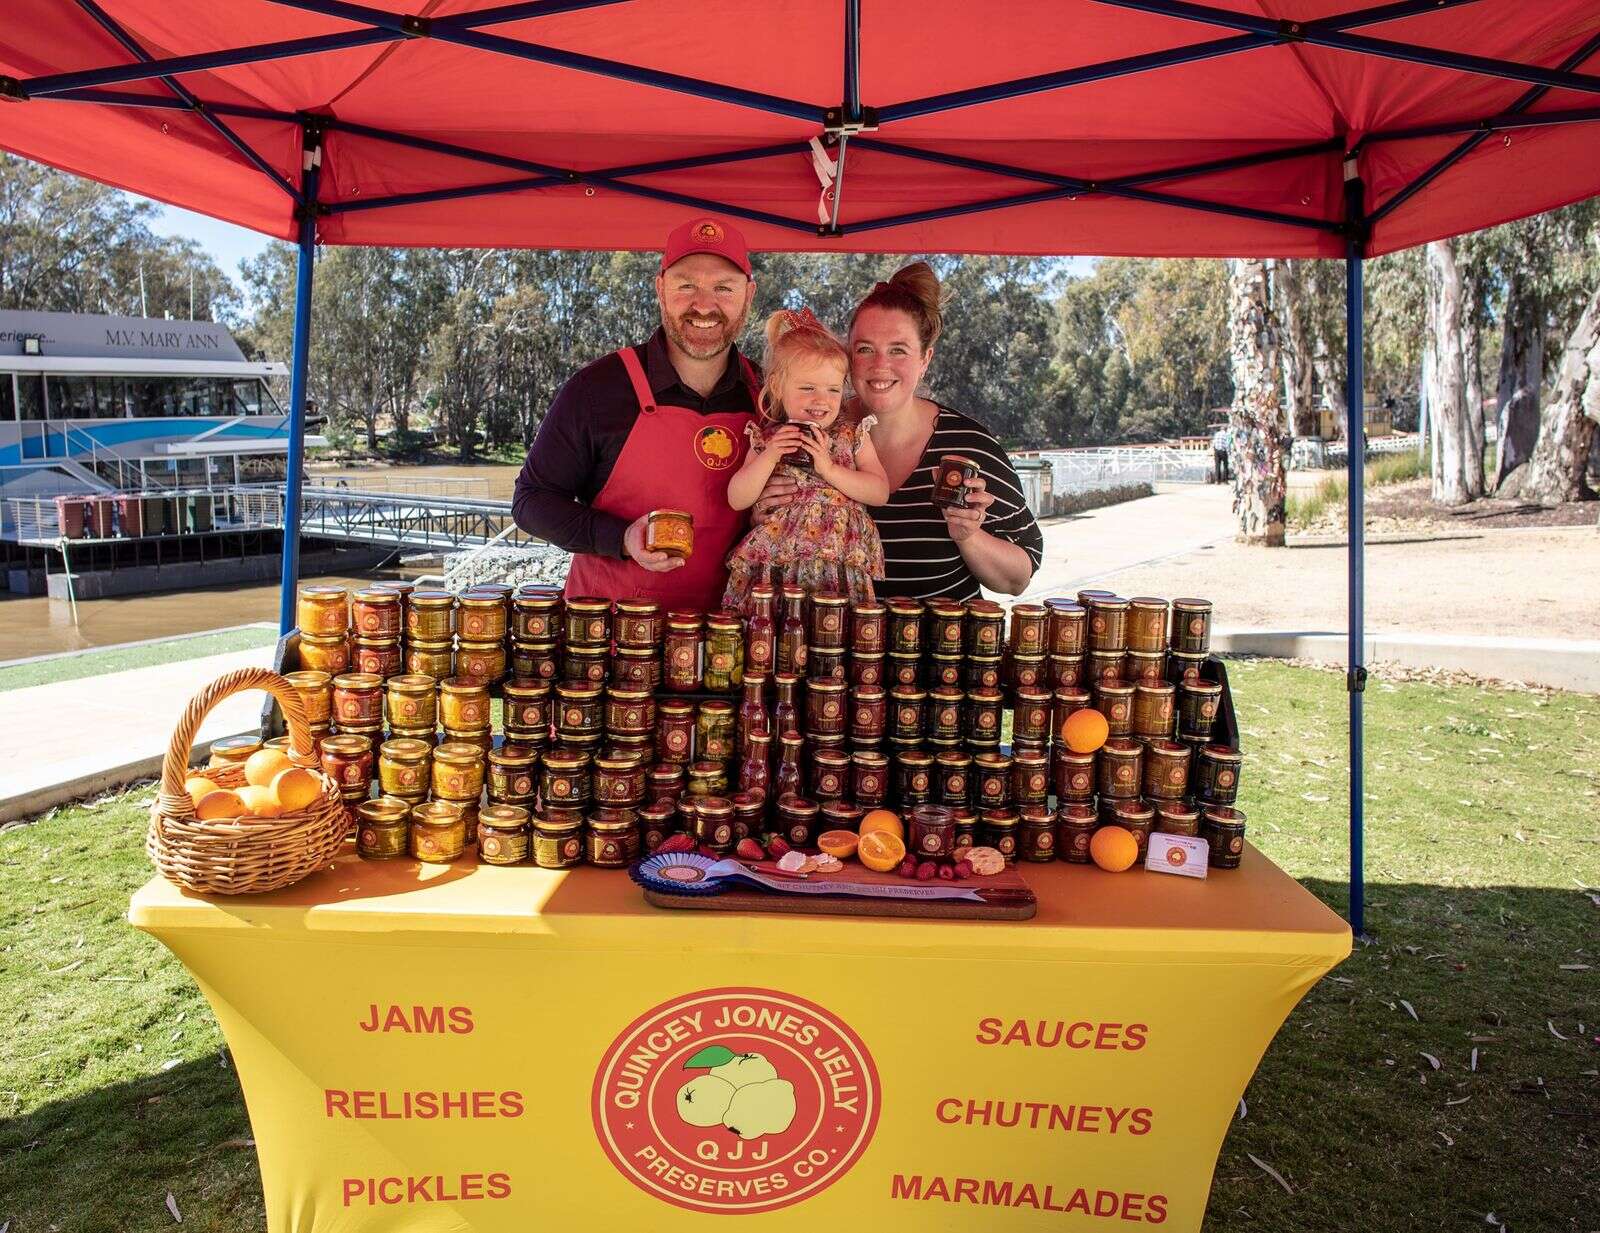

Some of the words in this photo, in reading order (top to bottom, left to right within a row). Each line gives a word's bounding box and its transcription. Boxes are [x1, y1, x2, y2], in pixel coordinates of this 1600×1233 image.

[140, 331, 181, 348] MARY
[186, 334, 219, 349] ANN
[359, 1004, 475, 1034] JAMS
[975, 1017, 1149, 1051] SAUCES
[614, 1010, 704, 1109] QUINCEY
[714, 1005, 820, 1046] JONES
[814, 1046, 859, 1115] JELLY
[324, 1089, 525, 1120] RELISHES
[935, 1098, 1153, 1136] CHUTNEYS
[634, 1145, 789, 1198] PRESERVES
[793, 1147, 838, 1179] CO.
[342, 1173, 512, 1207] PICKLES
[890, 1174, 1169, 1224] MARMALADES
